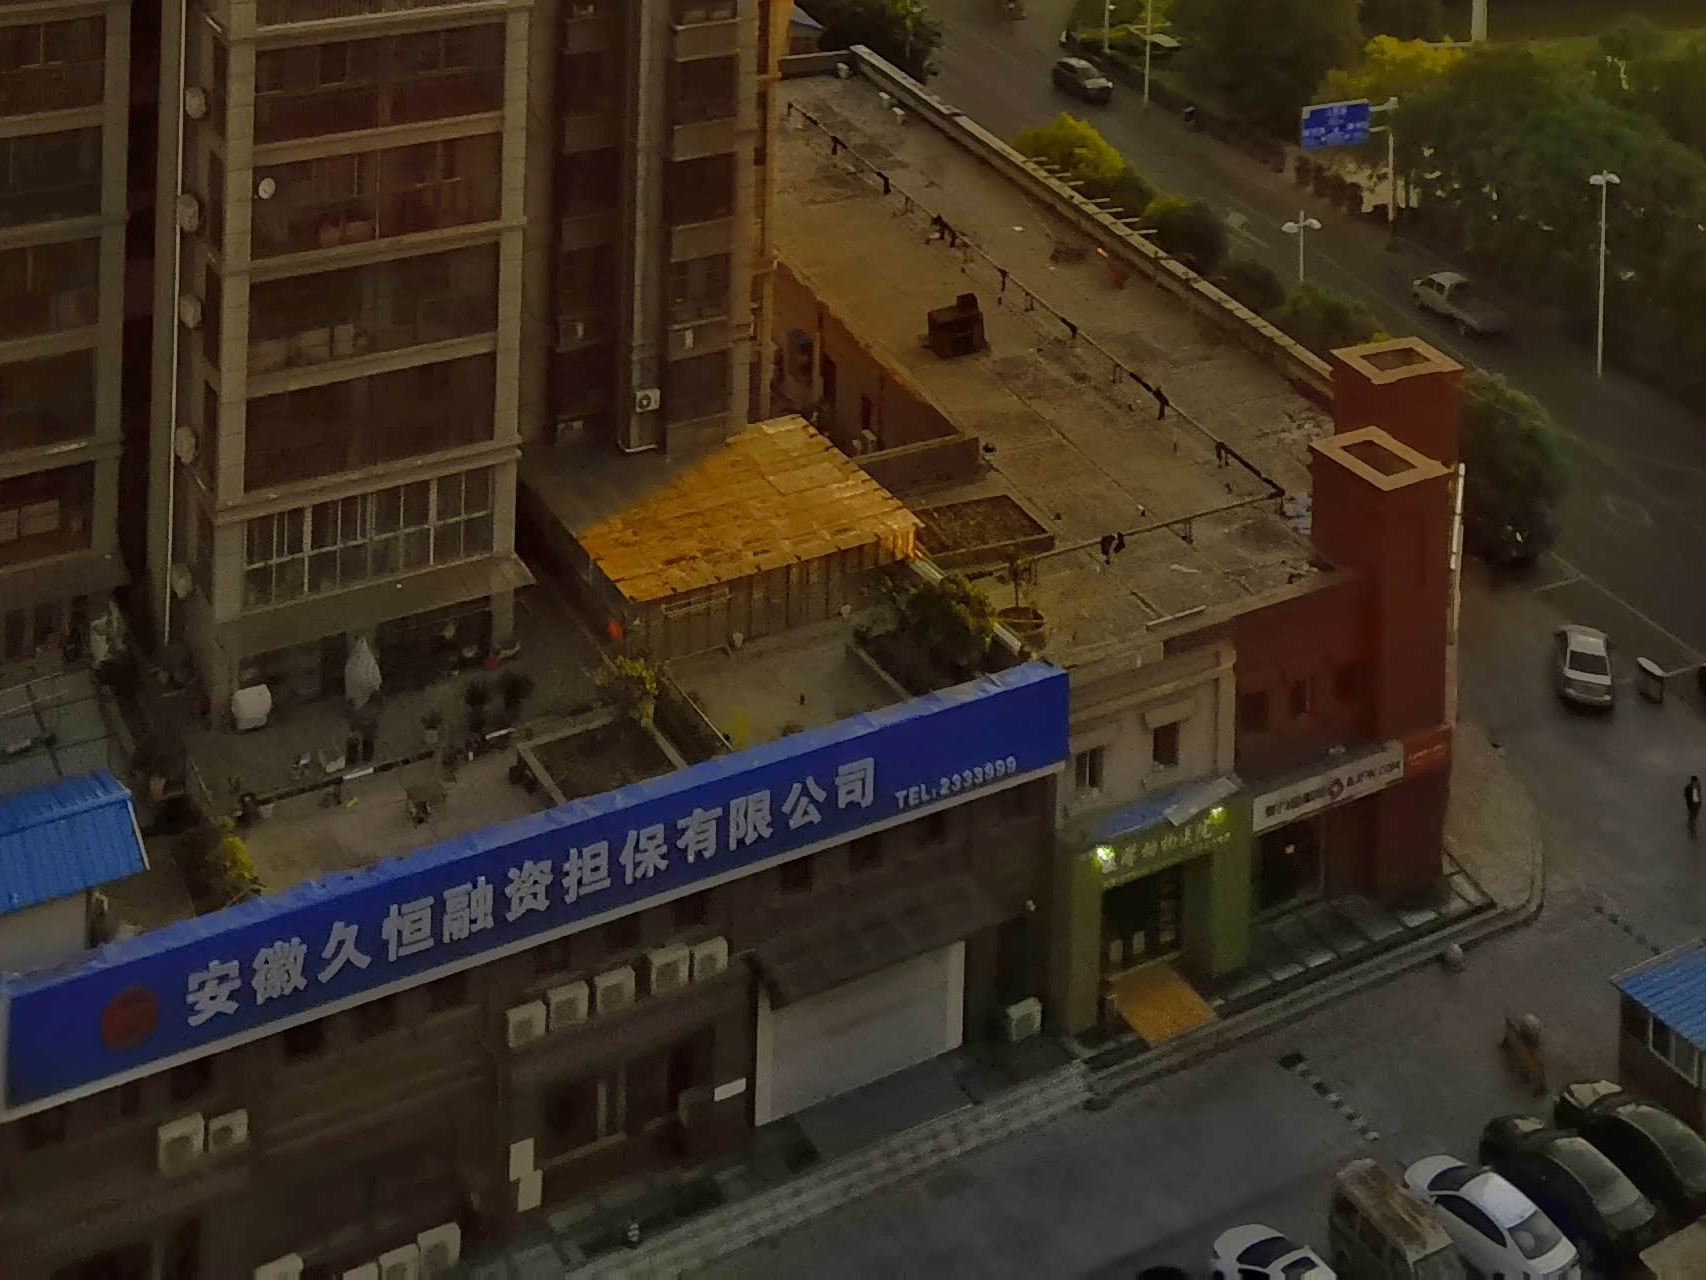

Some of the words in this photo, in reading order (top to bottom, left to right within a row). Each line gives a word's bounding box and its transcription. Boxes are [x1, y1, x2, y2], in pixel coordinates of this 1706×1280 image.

[185, 757, 877, 1027] 安徽久恒融资担保有限公司
